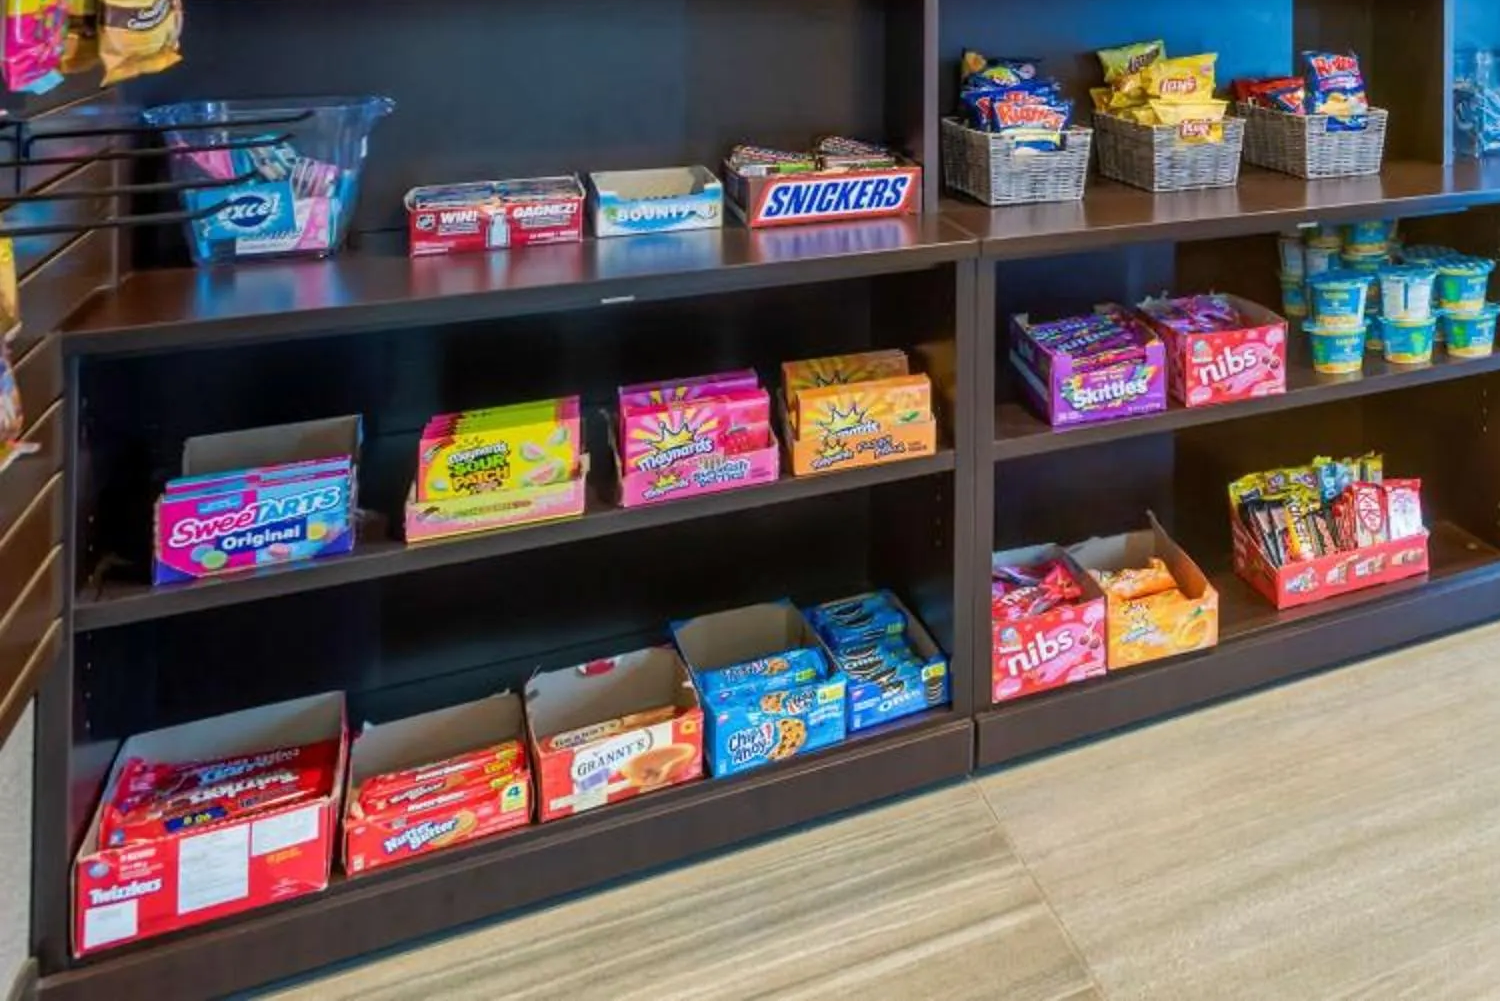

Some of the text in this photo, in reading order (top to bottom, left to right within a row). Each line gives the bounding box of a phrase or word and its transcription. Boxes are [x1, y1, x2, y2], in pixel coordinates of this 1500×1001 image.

[764, 175, 908, 219] SNICKERS
[440, 210, 479, 224] WIN!
[1199, 346, 1259, 386] nibs
[1072, 377, 1149, 410] Skittles
[637, 438, 715, 473] Maynards
[168, 486, 341, 548] SweeTARTS
[221, 524, 301, 552] Original
[1007, 630, 1074, 677] nibs
